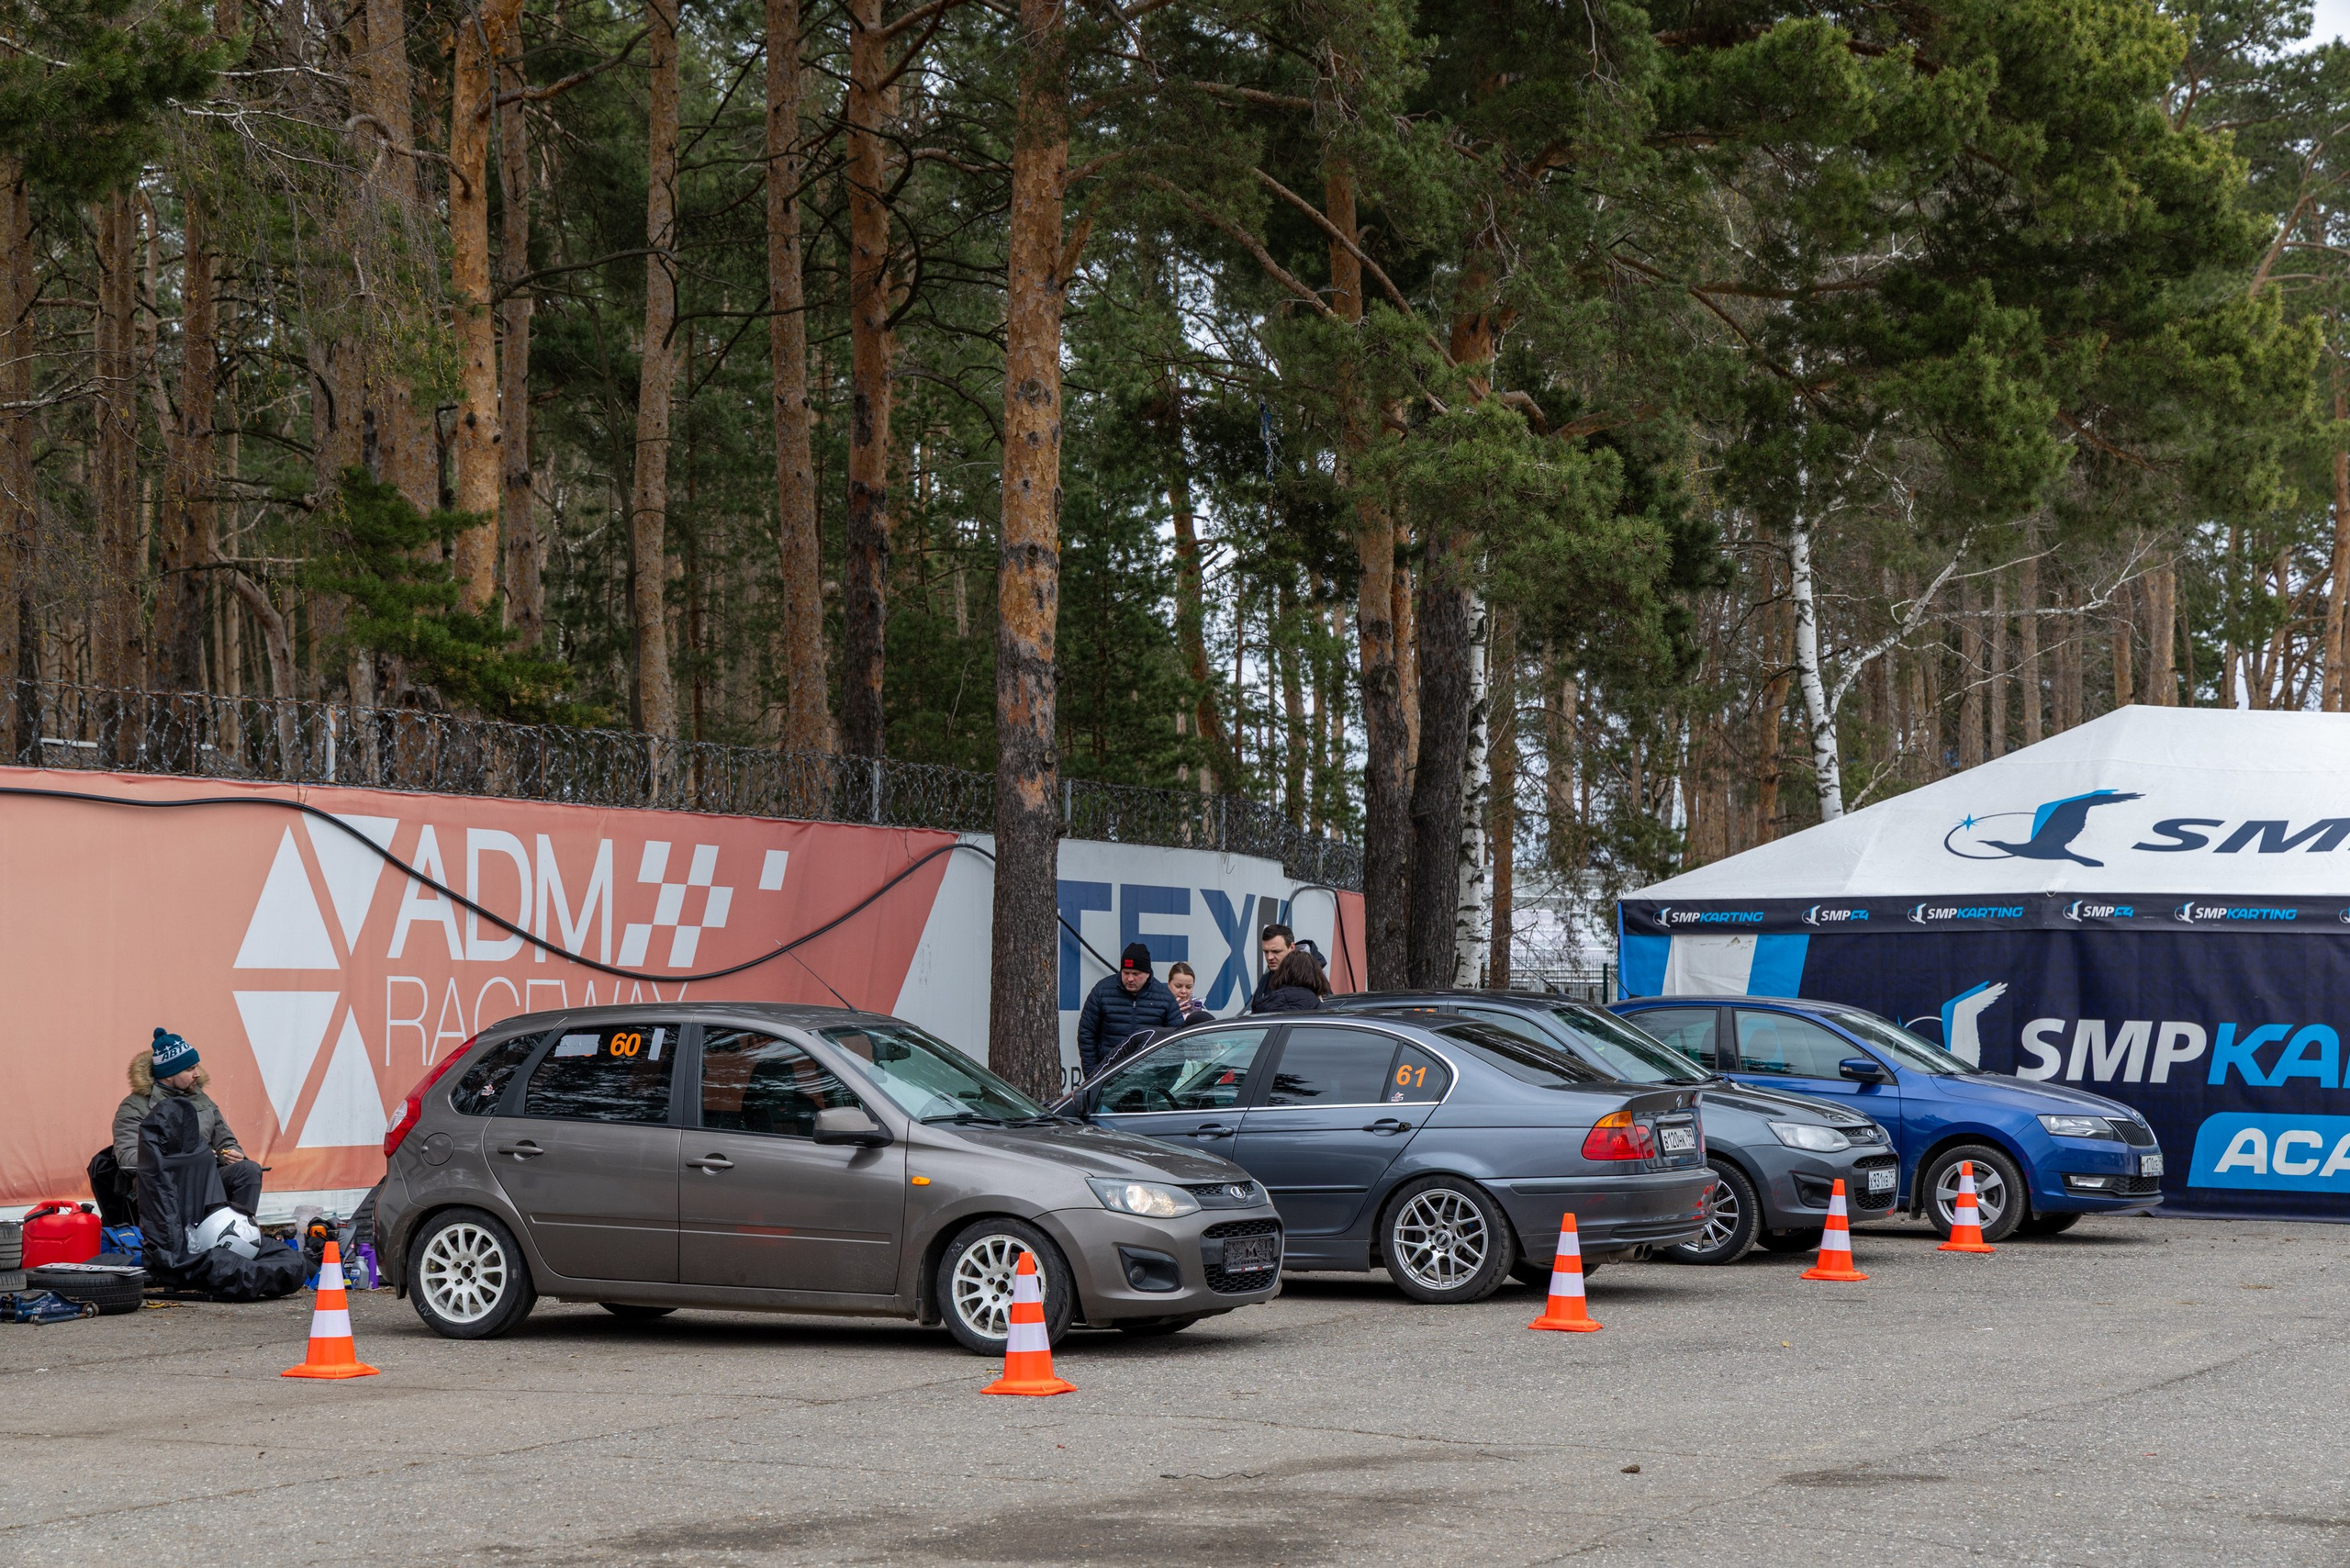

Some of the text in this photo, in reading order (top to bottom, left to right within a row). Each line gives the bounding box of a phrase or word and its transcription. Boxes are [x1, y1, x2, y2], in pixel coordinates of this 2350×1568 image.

[2131, 818, 2350, 854] SM
[386, 824, 613, 965] ADM
[1671, 911, 1764, 924] SMPKARTING
[1927, 905, 2024, 920] SMPKARTING
[2195, 907, 2298, 921] SMPKARTING
[610, 1033, 642, 1057] 60
[2016, 1018, 2350, 1089] SMPKA
[1396, 1064, 1427, 1088] 61
